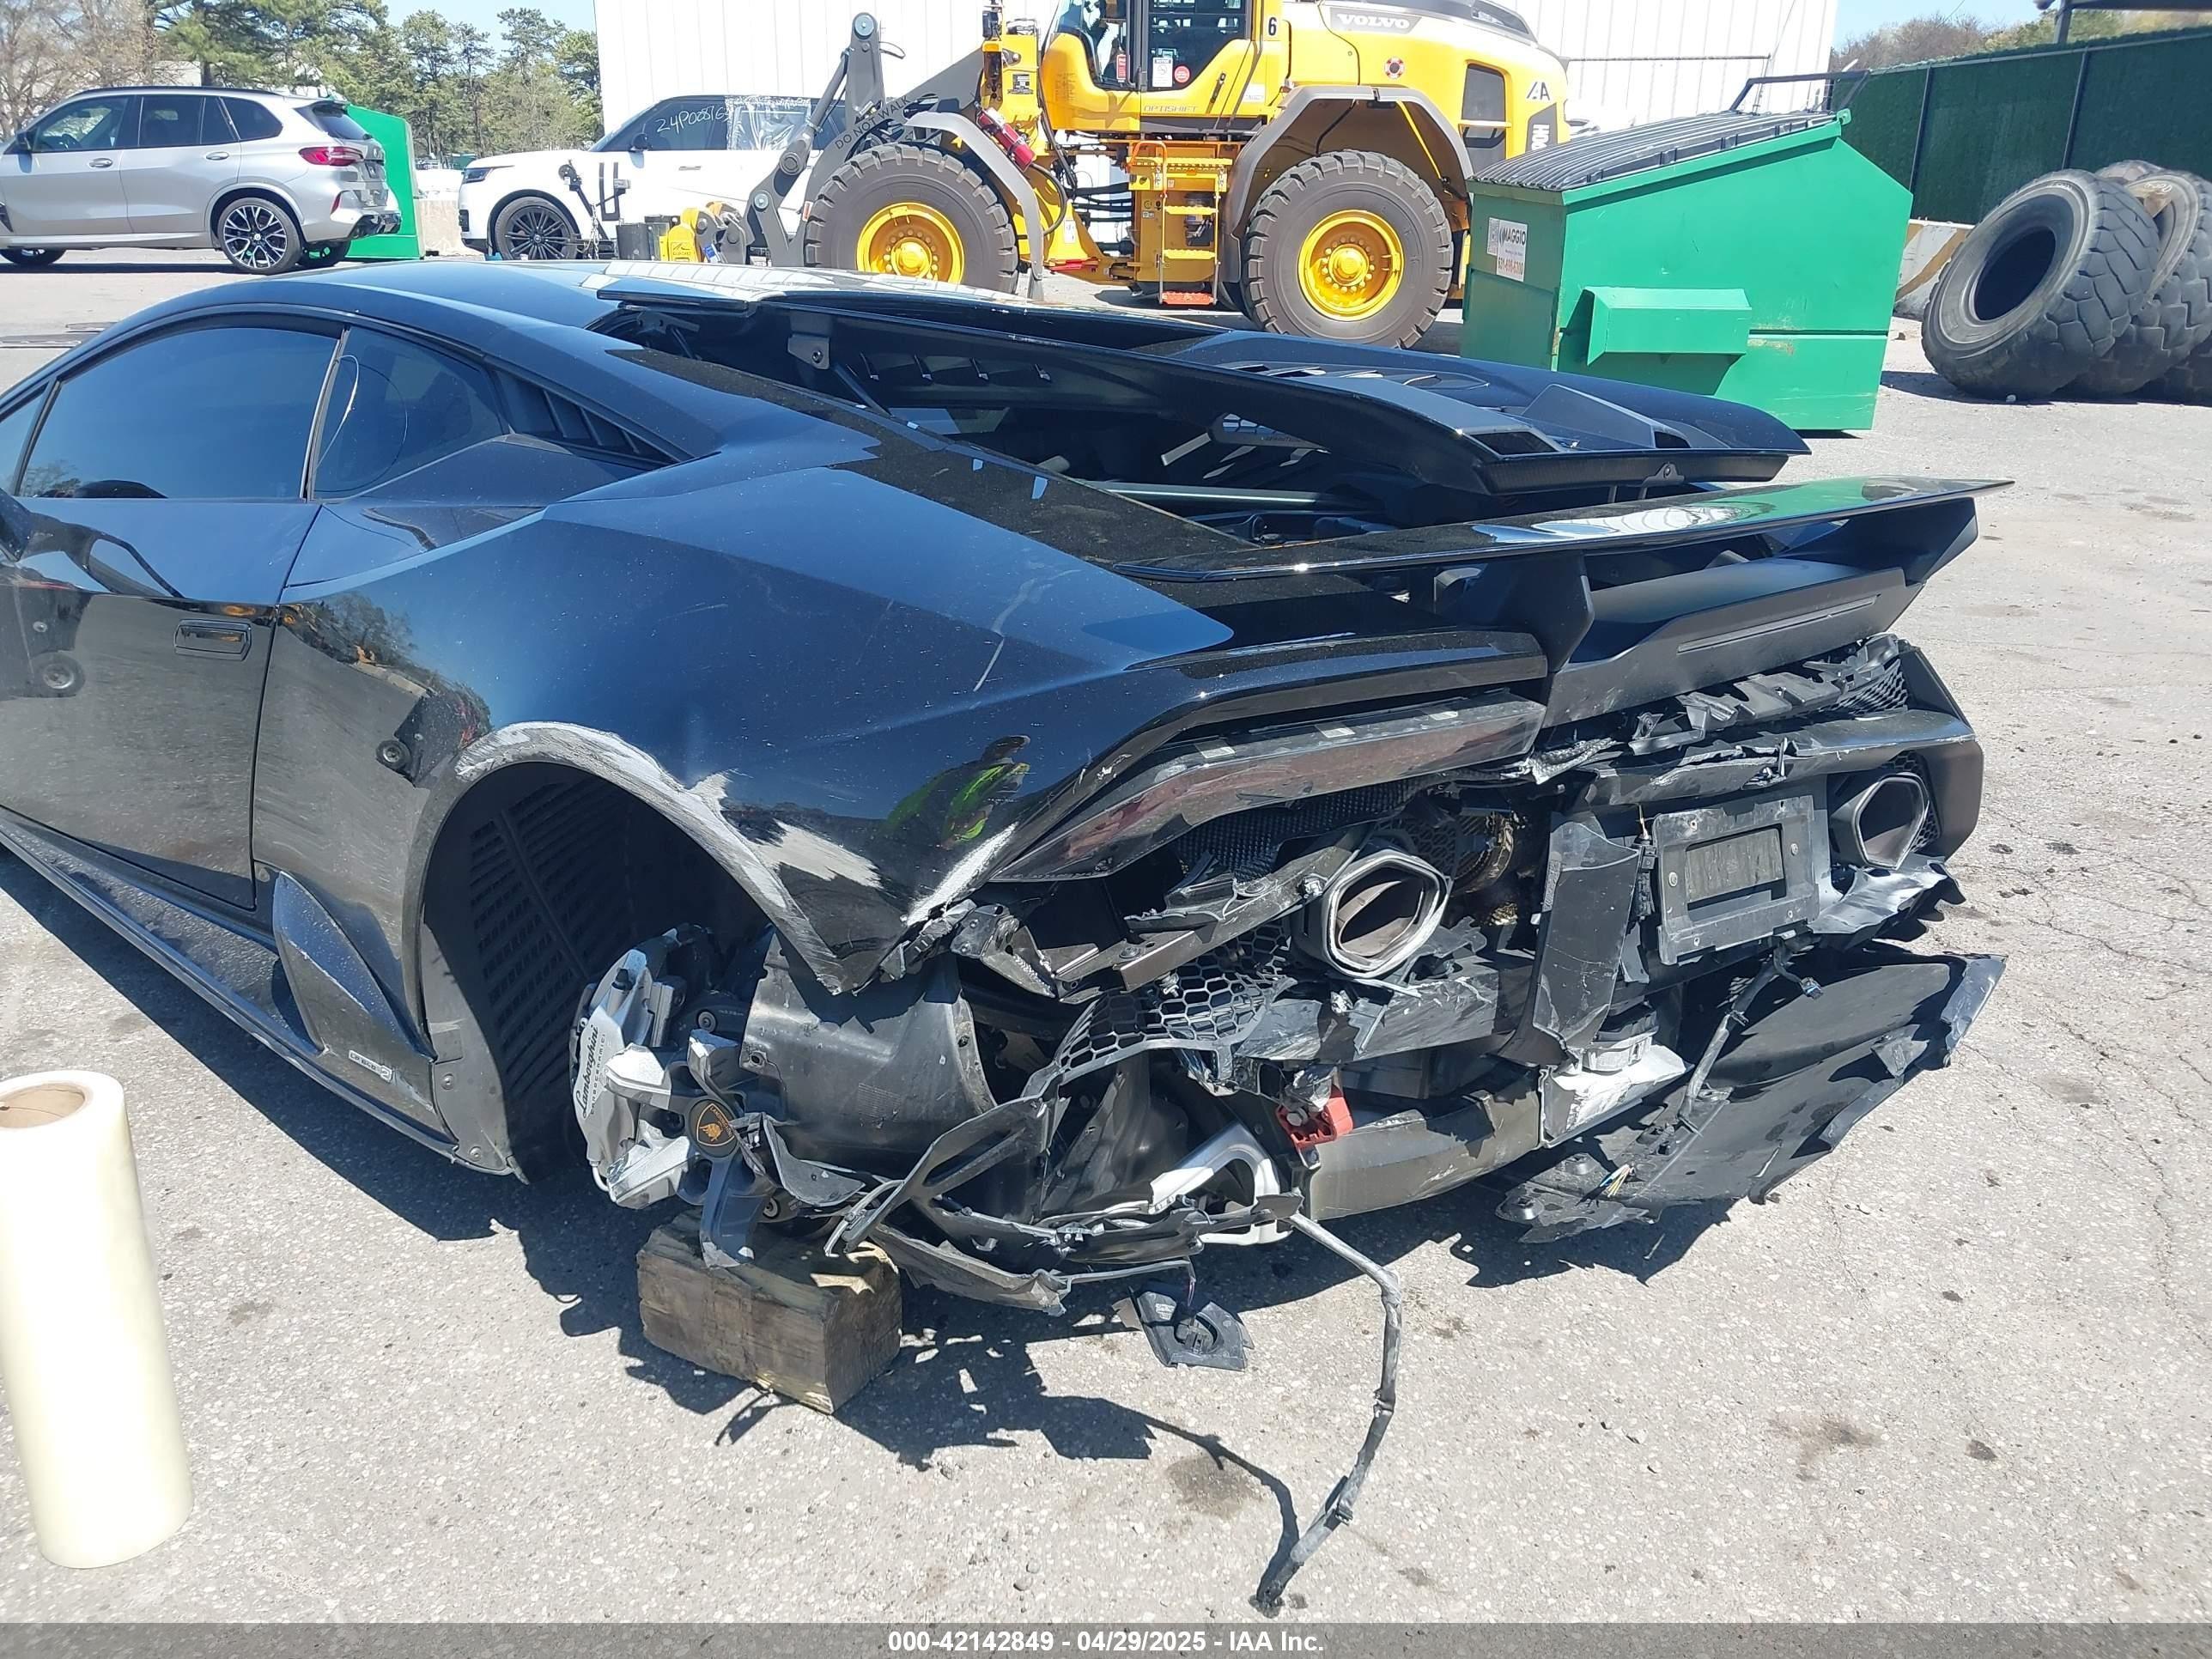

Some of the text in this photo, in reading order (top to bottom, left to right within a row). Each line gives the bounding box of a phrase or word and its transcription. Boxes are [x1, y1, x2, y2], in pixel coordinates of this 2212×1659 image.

[1267, 16, 1277, 36] 6
[1336, 13, 1410, 29] VOLVO
[835, 95, 911, 149] DO NOT WALK
[1504, 227, 1526, 246] MAGGIO
[575, 1024, 599, 1119] Lamborghini
